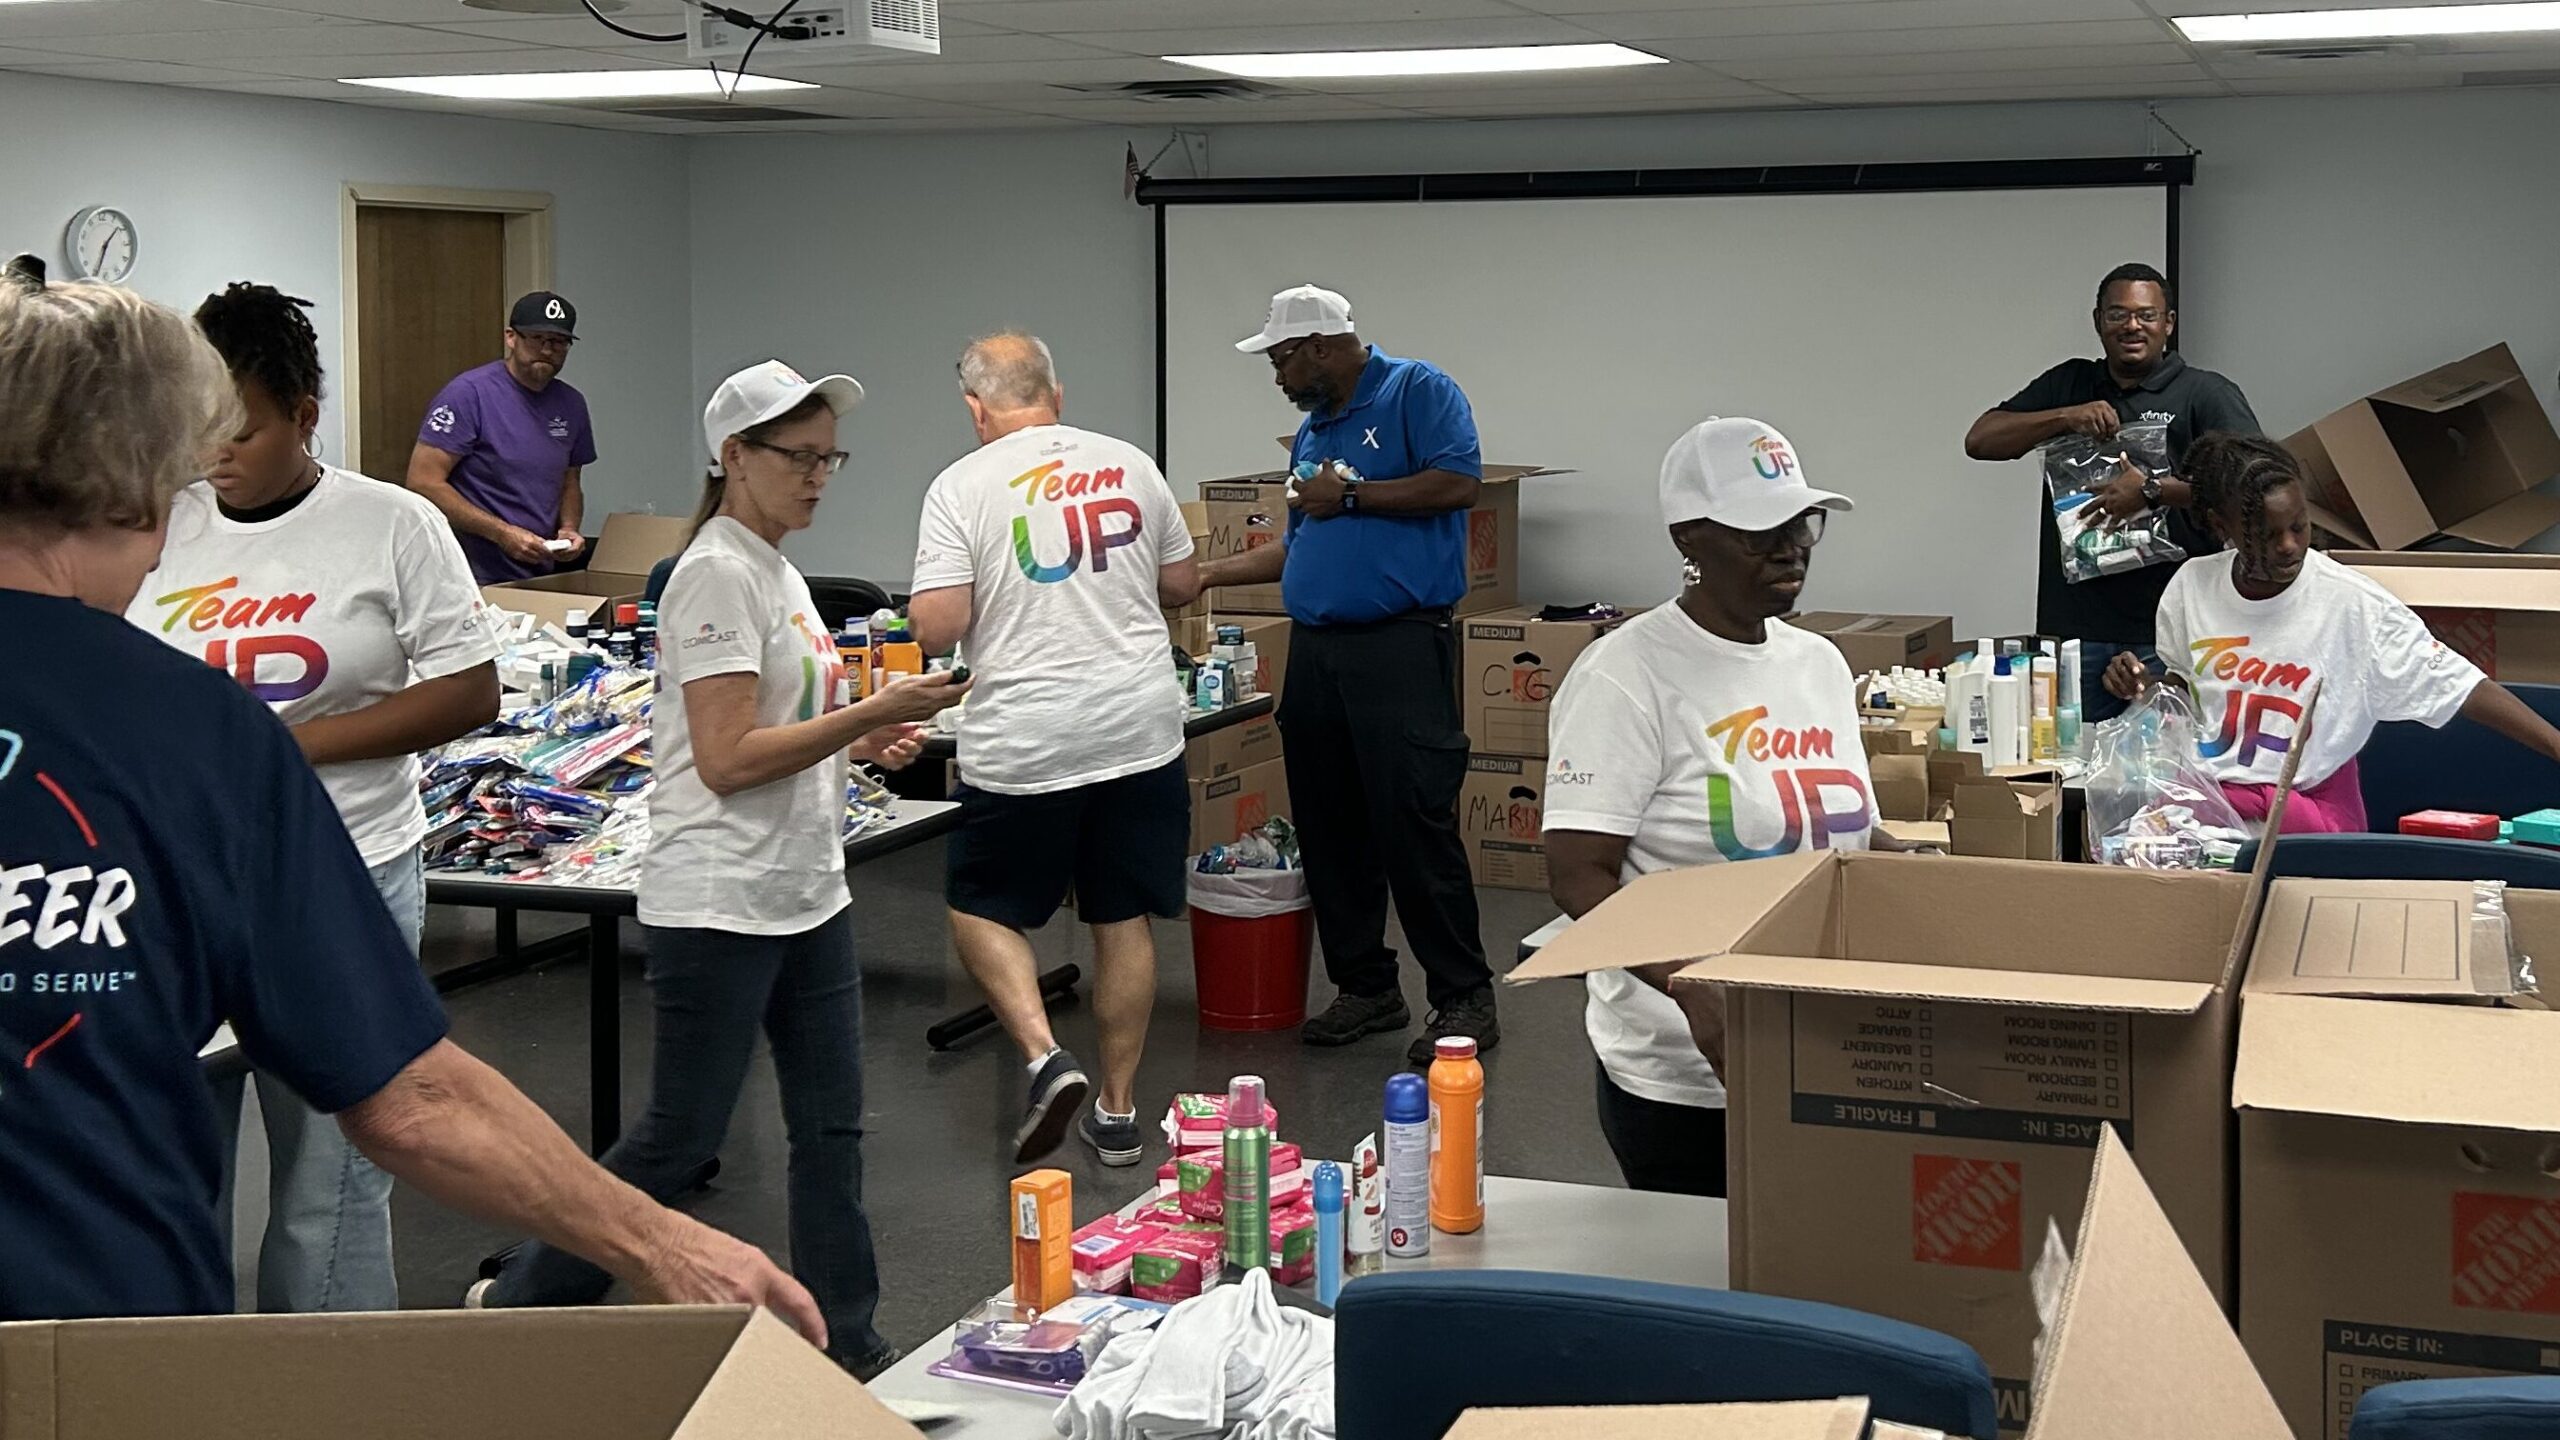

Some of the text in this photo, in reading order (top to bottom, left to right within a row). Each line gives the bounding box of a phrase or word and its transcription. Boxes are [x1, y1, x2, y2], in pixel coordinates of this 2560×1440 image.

[1748, 435, 1784, 453] Team
[1752, 451, 1795, 480] UP
[1009, 459, 1125, 506] Team
[1210, 488, 1256, 500] MEDIUM
[1012, 497, 1143, 584] UP
[156, 576, 316, 632] Team
[1473, 626, 1521, 639] MEDIUM
[2190, 636, 2311, 692] Team
[1705, 705, 1834, 765] Team
[1471, 759, 1520, 773] MEDIUM
[1707, 768, 1870, 861] UP
[1876, 1005, 1912, 1020] ATTIC
[1858, 1023, 1912, 1037] GARAGE
[2003, 1016, 2097, 1033] DINING ROOM
[1841, 1039, 1912, 1055] BASEMENT
[2008, 1034, 2097, 1050] LIVING ROOM
[1851, 1058, 1912, 1073] LAUNDRY
[2004, 1052, 2097, 1069] FAMILY ROOM
[1856, 1076, 1912, 1091] KITCHEN
[2027, 1072, 2097, 1087] BEDROOM
[2036, 1090, 2097, 1106] PRIMARY
[1834, 1104, 1912, 1125] FRAGILE
[2022, 1119, 2100, 1140] ACE IN:
[2340, 1329, 2443, 1355] PLACE IN:
